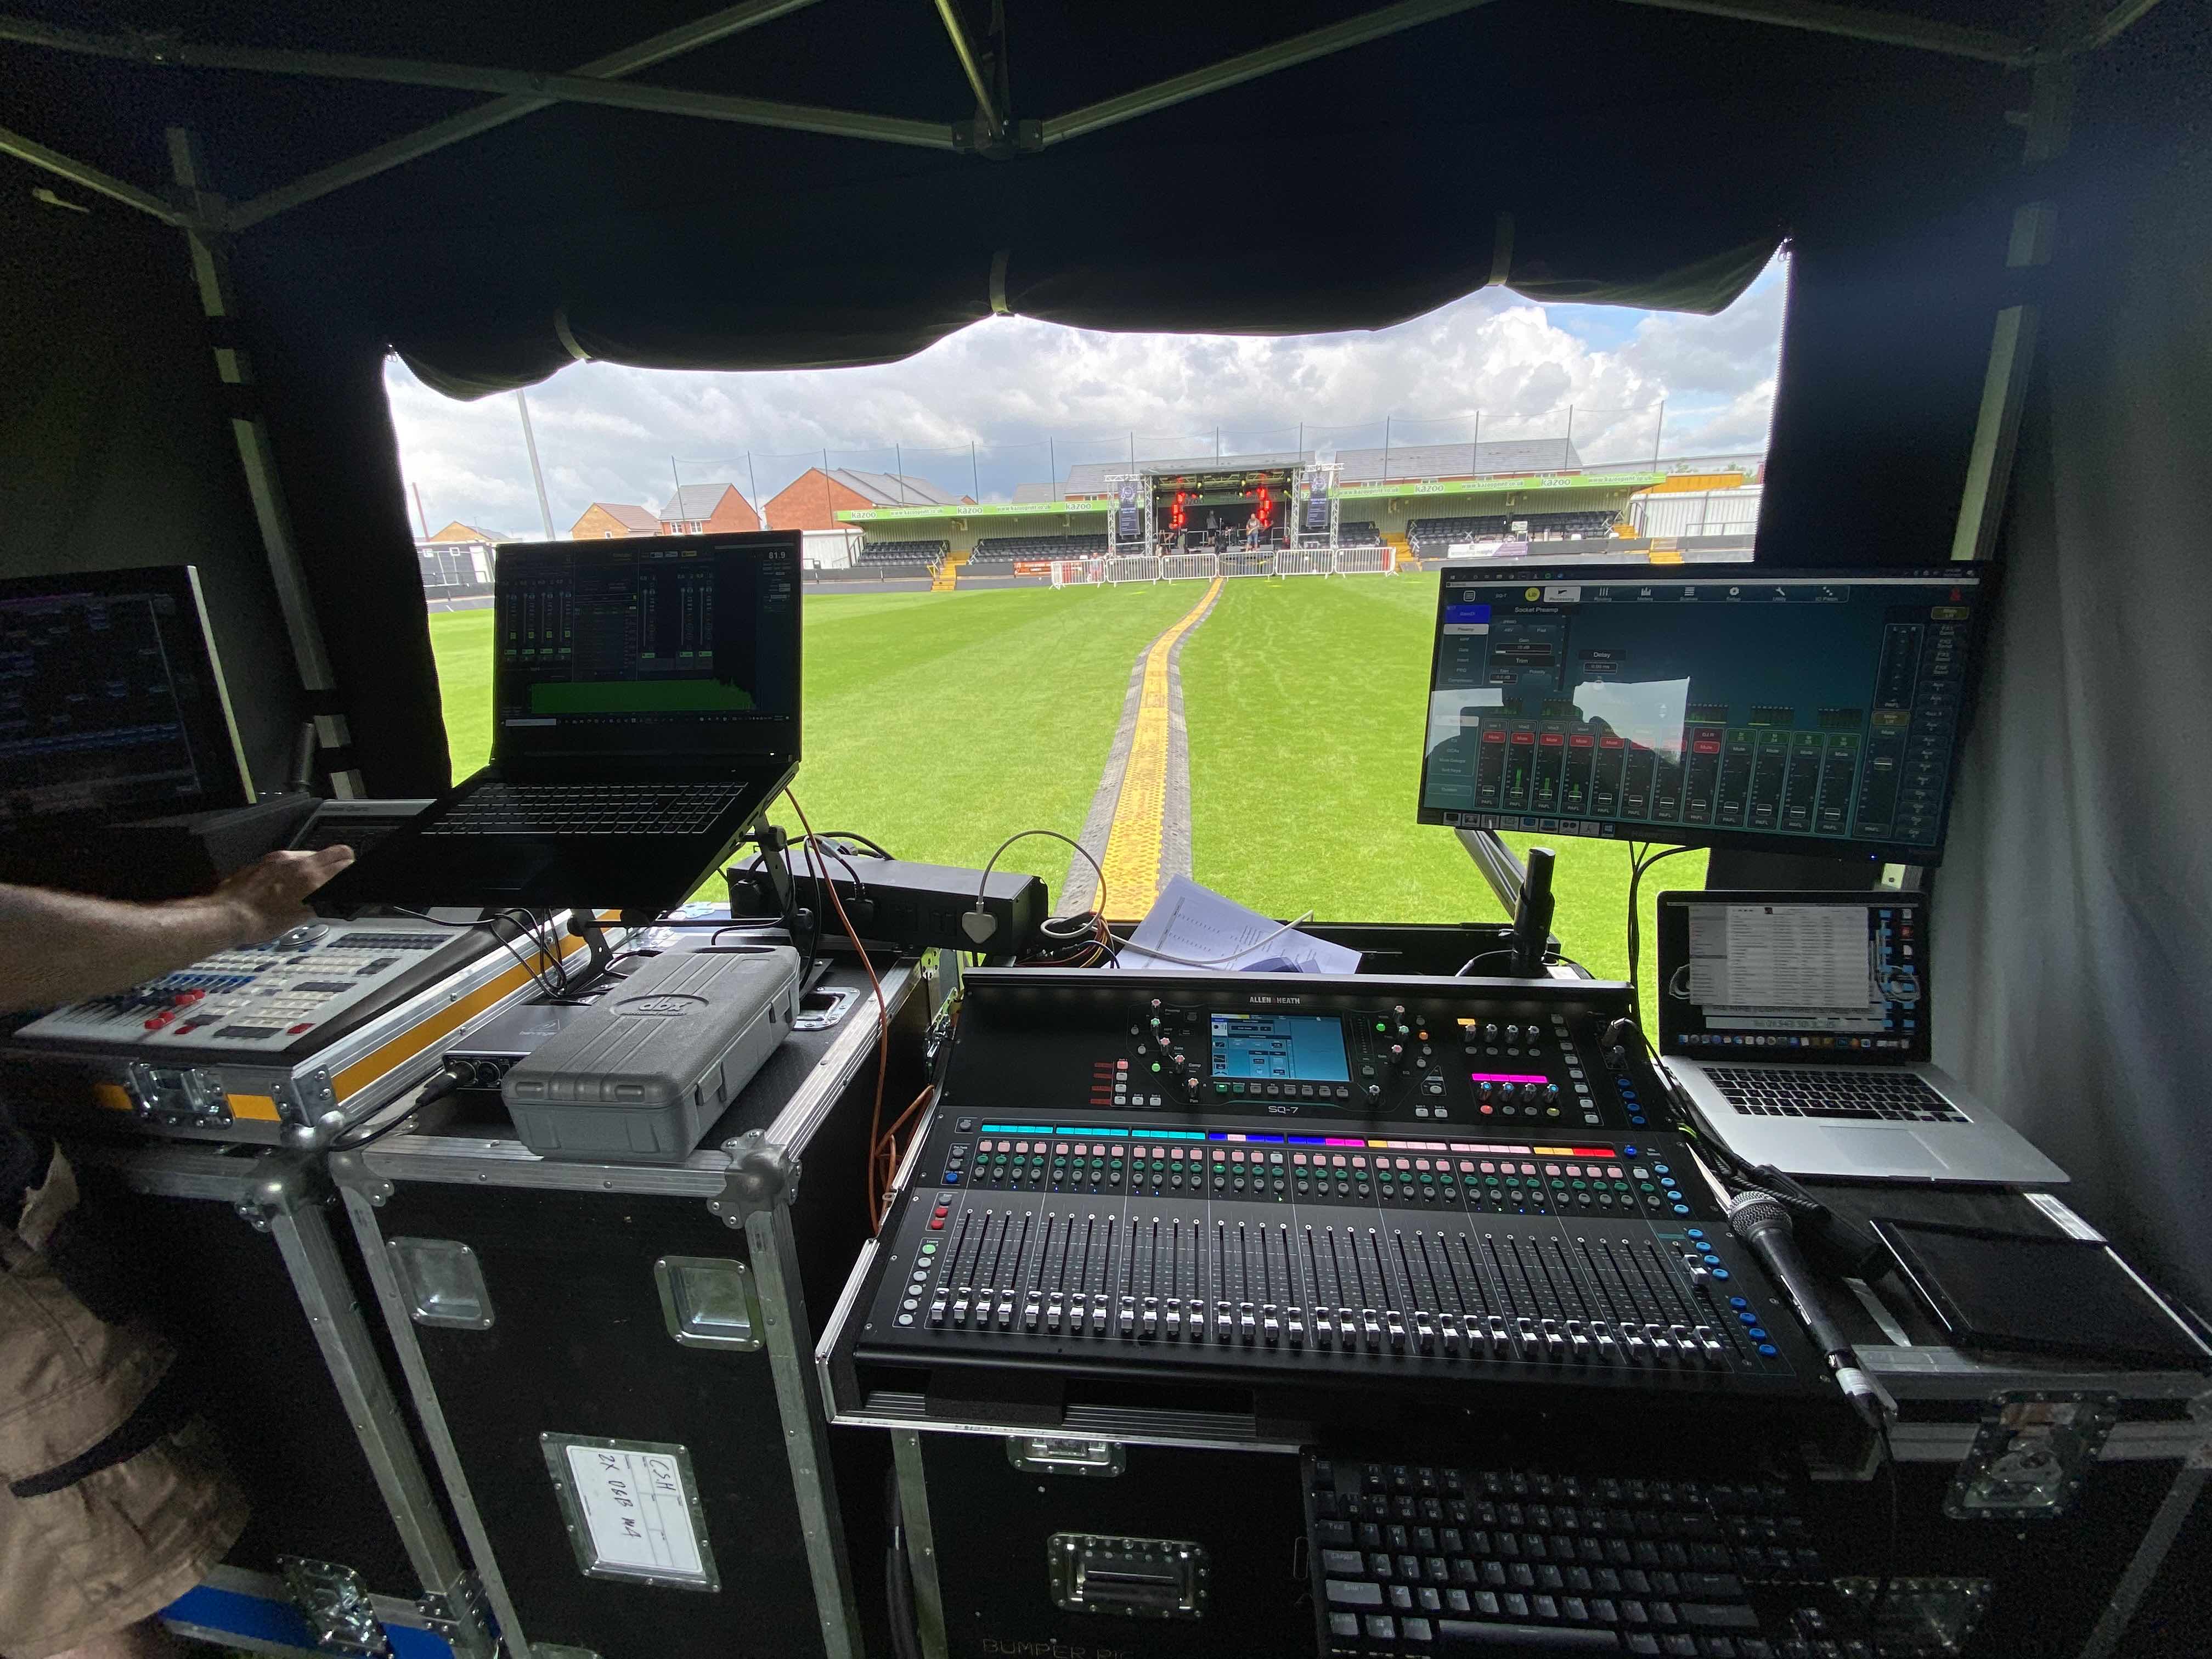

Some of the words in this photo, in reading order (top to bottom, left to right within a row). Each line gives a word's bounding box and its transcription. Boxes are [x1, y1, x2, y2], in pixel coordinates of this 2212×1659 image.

[1415, 484, 1444, 493] kazoo
[639, 996, 684, 1011] dbx
[1268, 1105, 1299, 1114] SQ-7
[983, 1638, 1086, 1659] BUMPER
